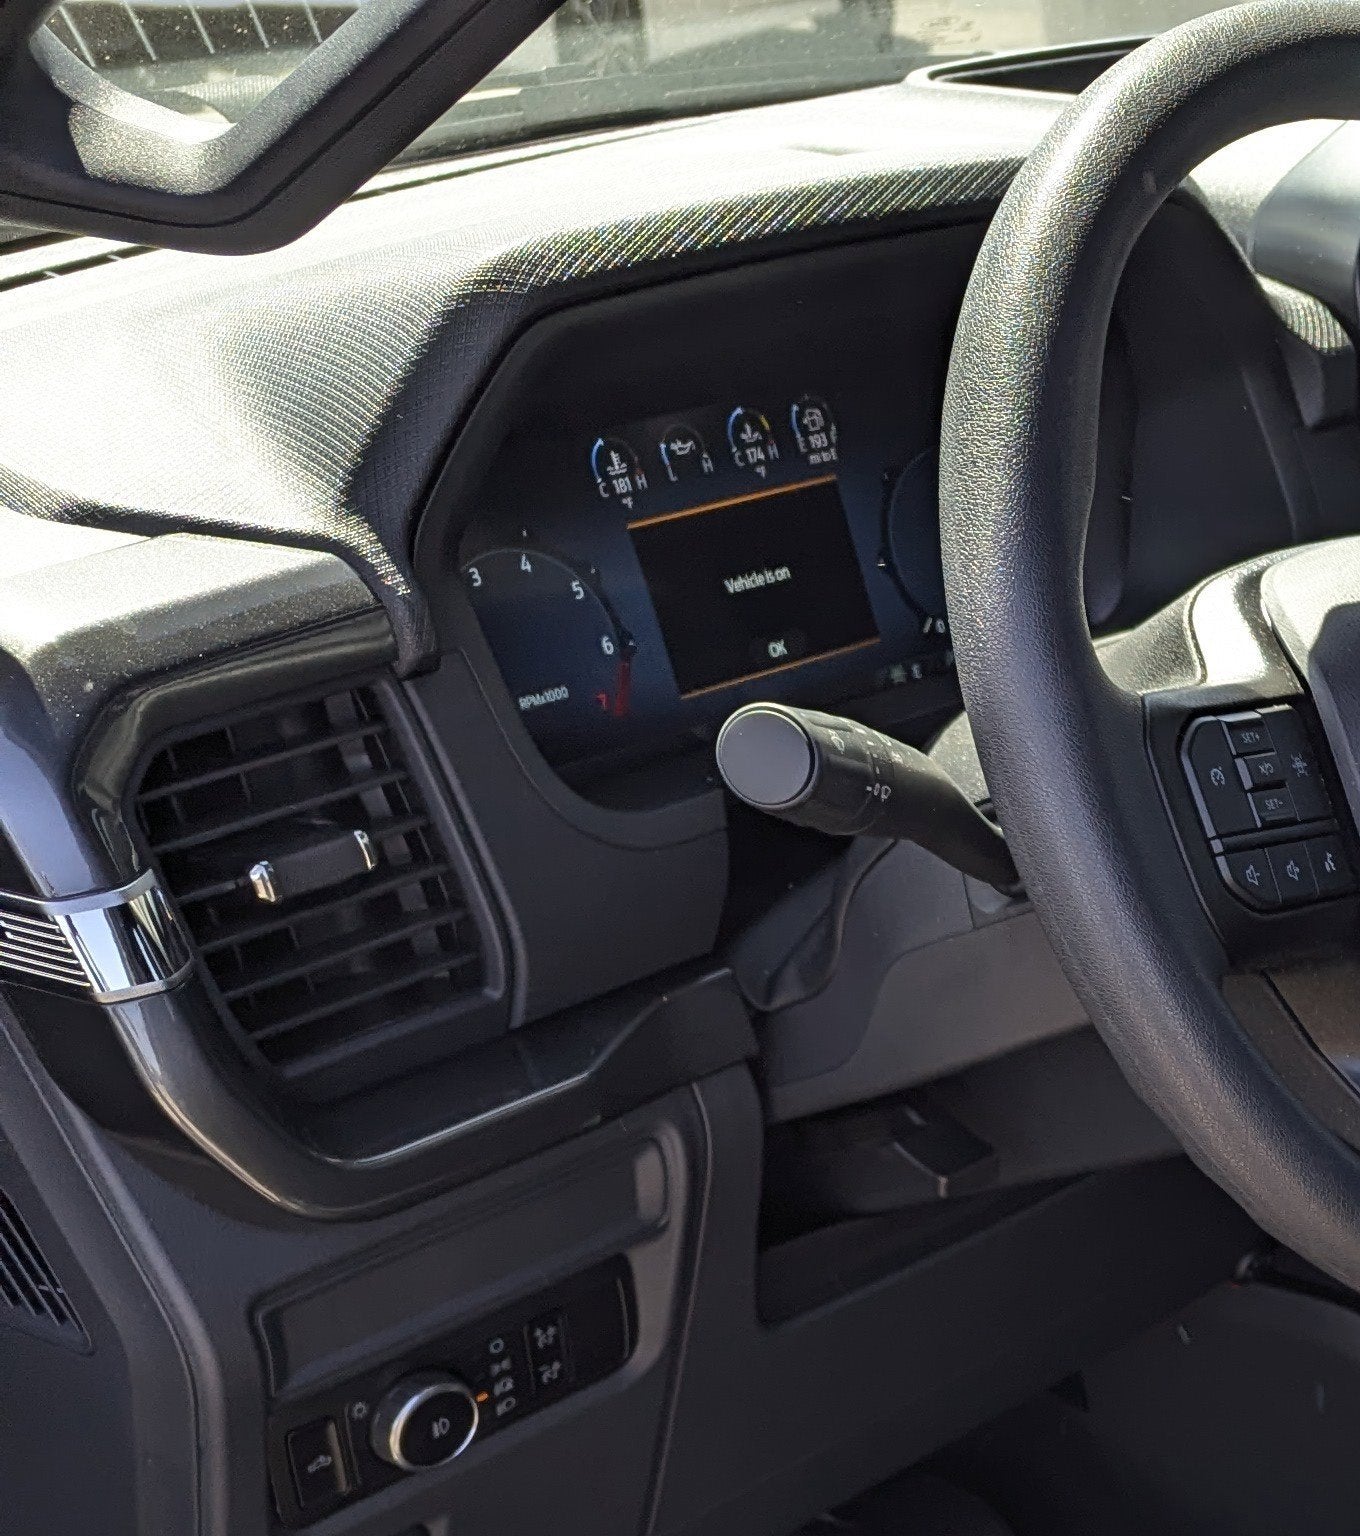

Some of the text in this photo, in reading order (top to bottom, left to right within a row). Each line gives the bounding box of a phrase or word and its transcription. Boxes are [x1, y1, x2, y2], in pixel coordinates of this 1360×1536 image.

[747, 447, 766, 464] 174
[611, 477, 634, 495] 181
[520, 553, 533, 573] 4
[467, 566, 482, 588] 3
[723, 571, 767, 595] Vehicle
[774, 565, 791, 583] on
[571, 579, 585, 600] 5
[602, 635, 615, 656] 6
[767, 638, 788, 659] OK
